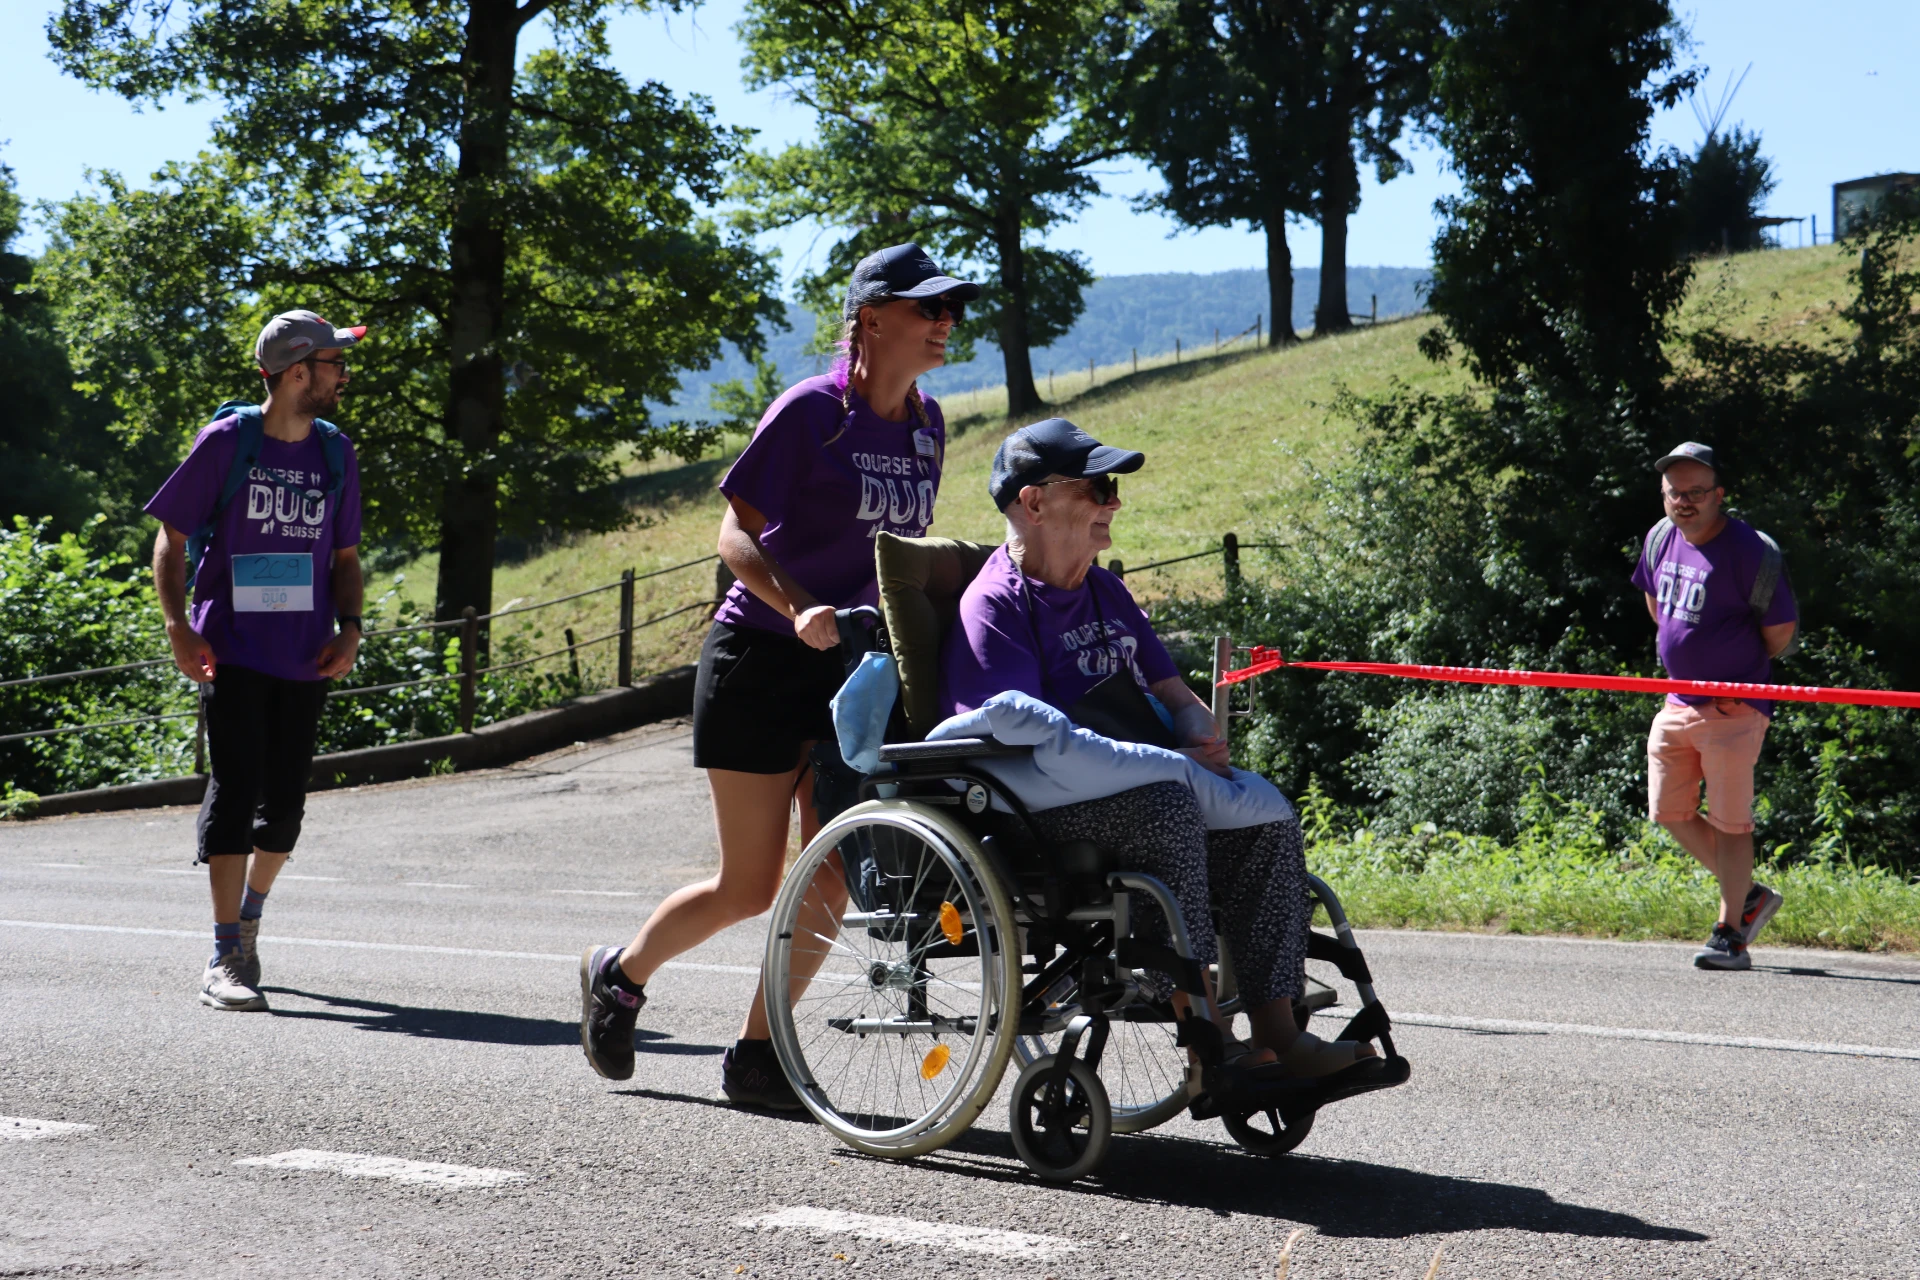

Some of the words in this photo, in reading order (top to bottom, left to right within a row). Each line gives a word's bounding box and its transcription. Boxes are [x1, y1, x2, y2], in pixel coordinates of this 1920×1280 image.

[852, 453, 912, 476] COURSE
[247, 484, 325, 526] DUO
[856, 474, 936, 528] DUO
[281, 525, 322, 540] SUISSE
[253, 556, 300, 580] 209
[1661, 561, 1696, 579] COURSE
[1657, 574, 1706, 612] DUO
